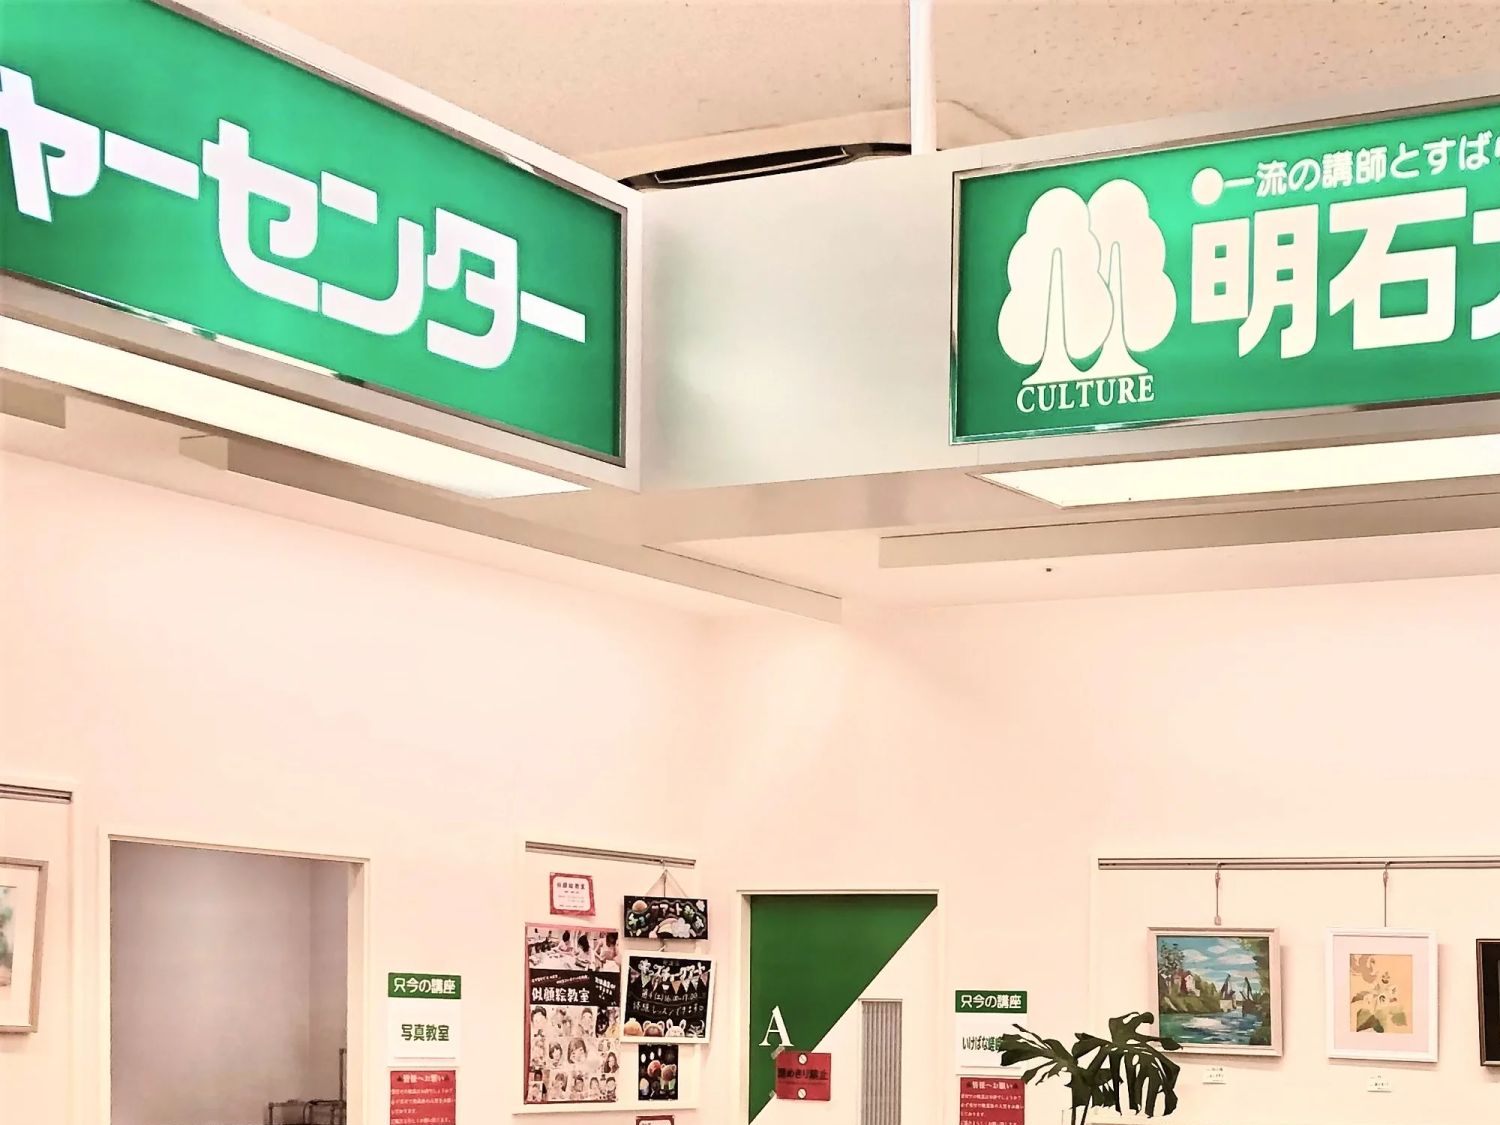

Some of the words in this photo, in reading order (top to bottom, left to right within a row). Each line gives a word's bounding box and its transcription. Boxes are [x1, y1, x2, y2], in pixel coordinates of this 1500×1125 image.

[1016, 373, 1156, 413] CULTURE
[393, 977, 457, 994] 只今の講座
[532, 986, 590, 1003] 似顔絵教室
[961, 994, 1022, 1009] 只今の講座
[401, 1024, 450, 1041] 写真教室
[759, 1005, 794, 1047] A
